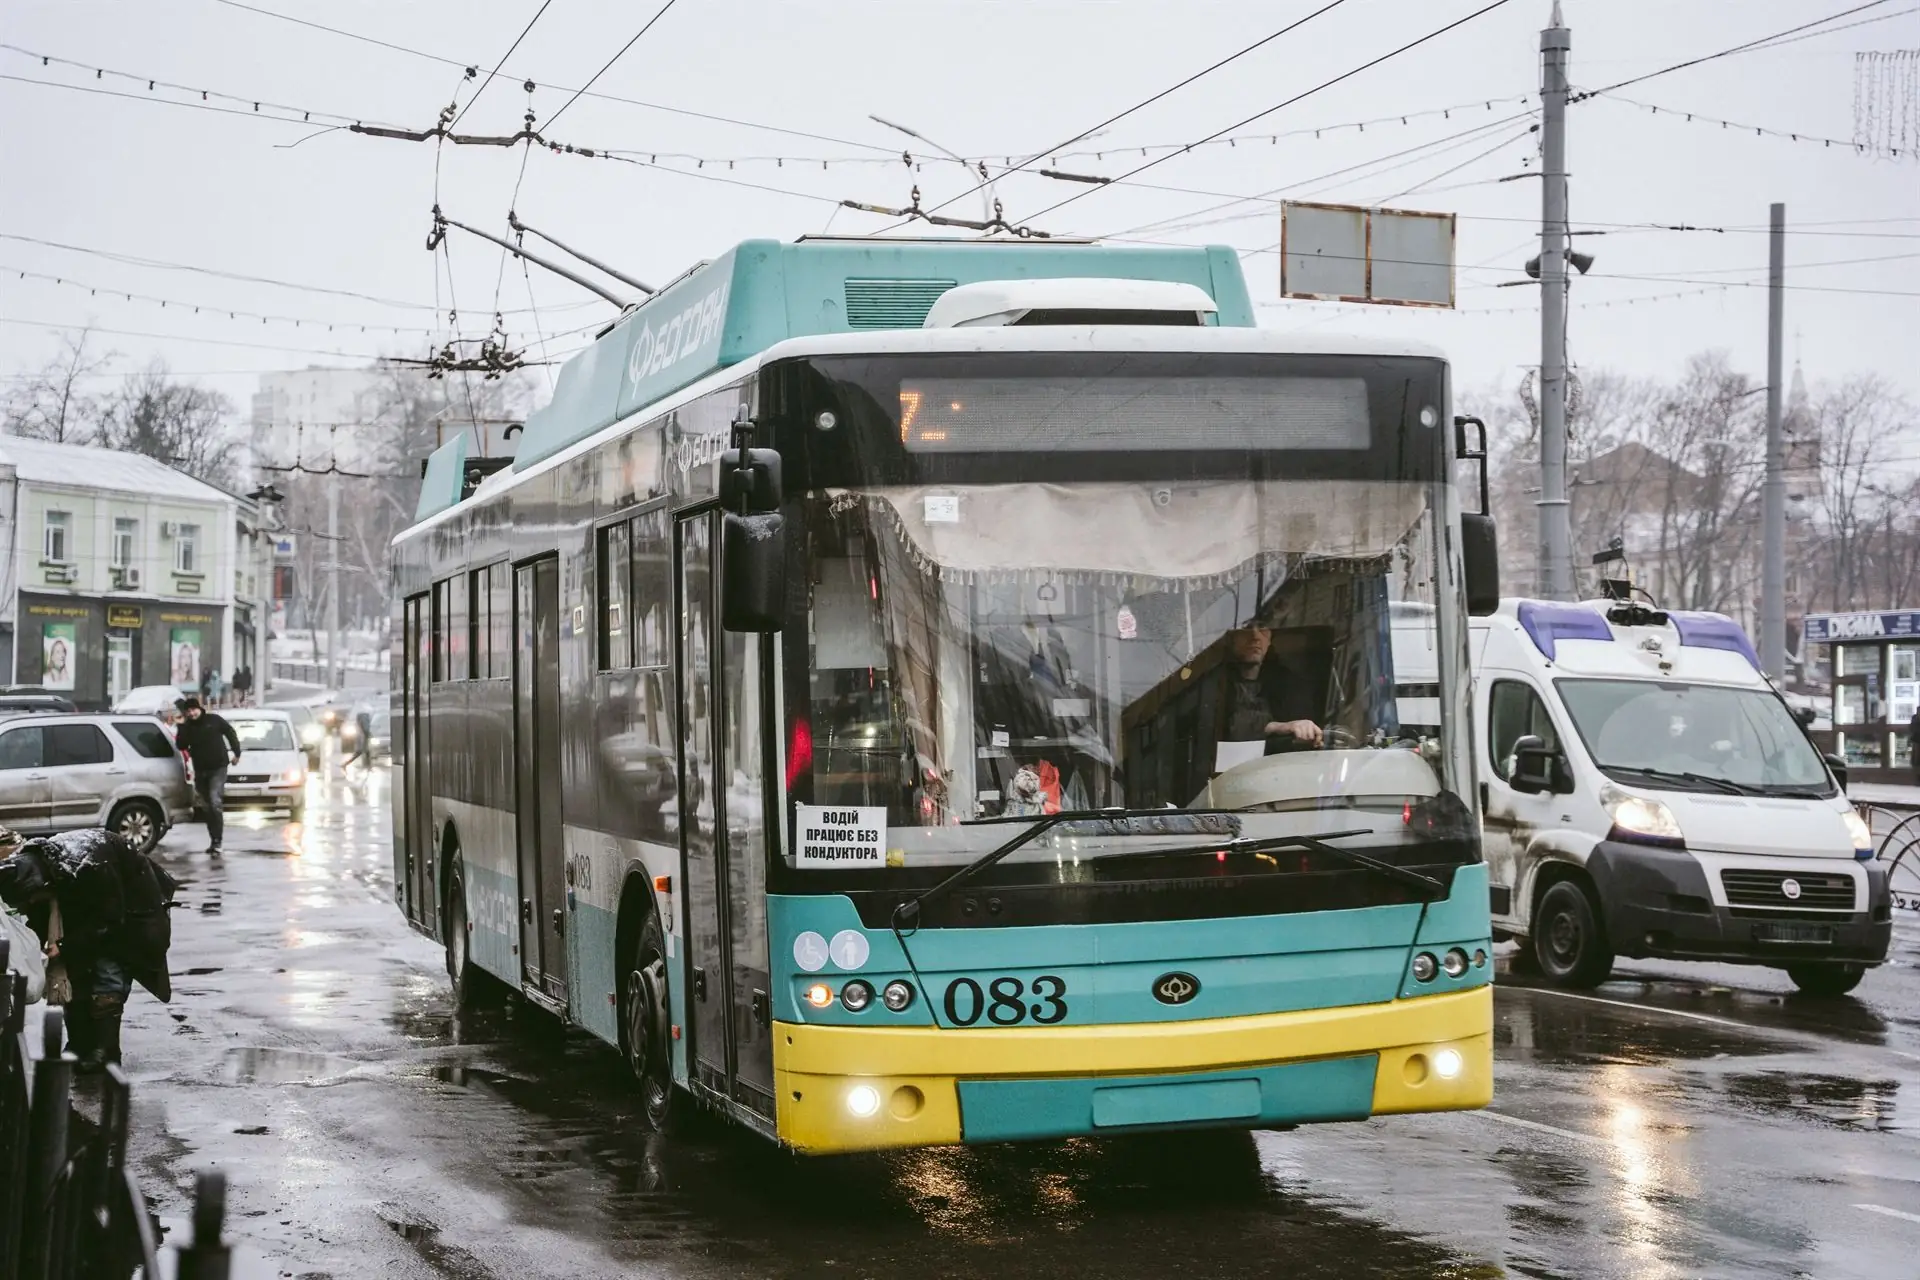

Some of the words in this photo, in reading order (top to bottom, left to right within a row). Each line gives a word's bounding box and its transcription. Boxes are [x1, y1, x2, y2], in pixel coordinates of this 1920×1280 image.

[649, 283, 727, 376] БОГДАН
[900, 392, 919, 442] 7
[693, 429, 731, 468] БОГДА
[806, 828, 854, 843] ПРАЦЮЄ
[857, 830, 878, 842] БЕЗ
[823, 810, 859, 826] ВОДІЙ
[575, 853, 591, 890] 083
[804, 845, 878, 861] КОНДУКТОРА
[944, 975, 1068, 1026] 083
